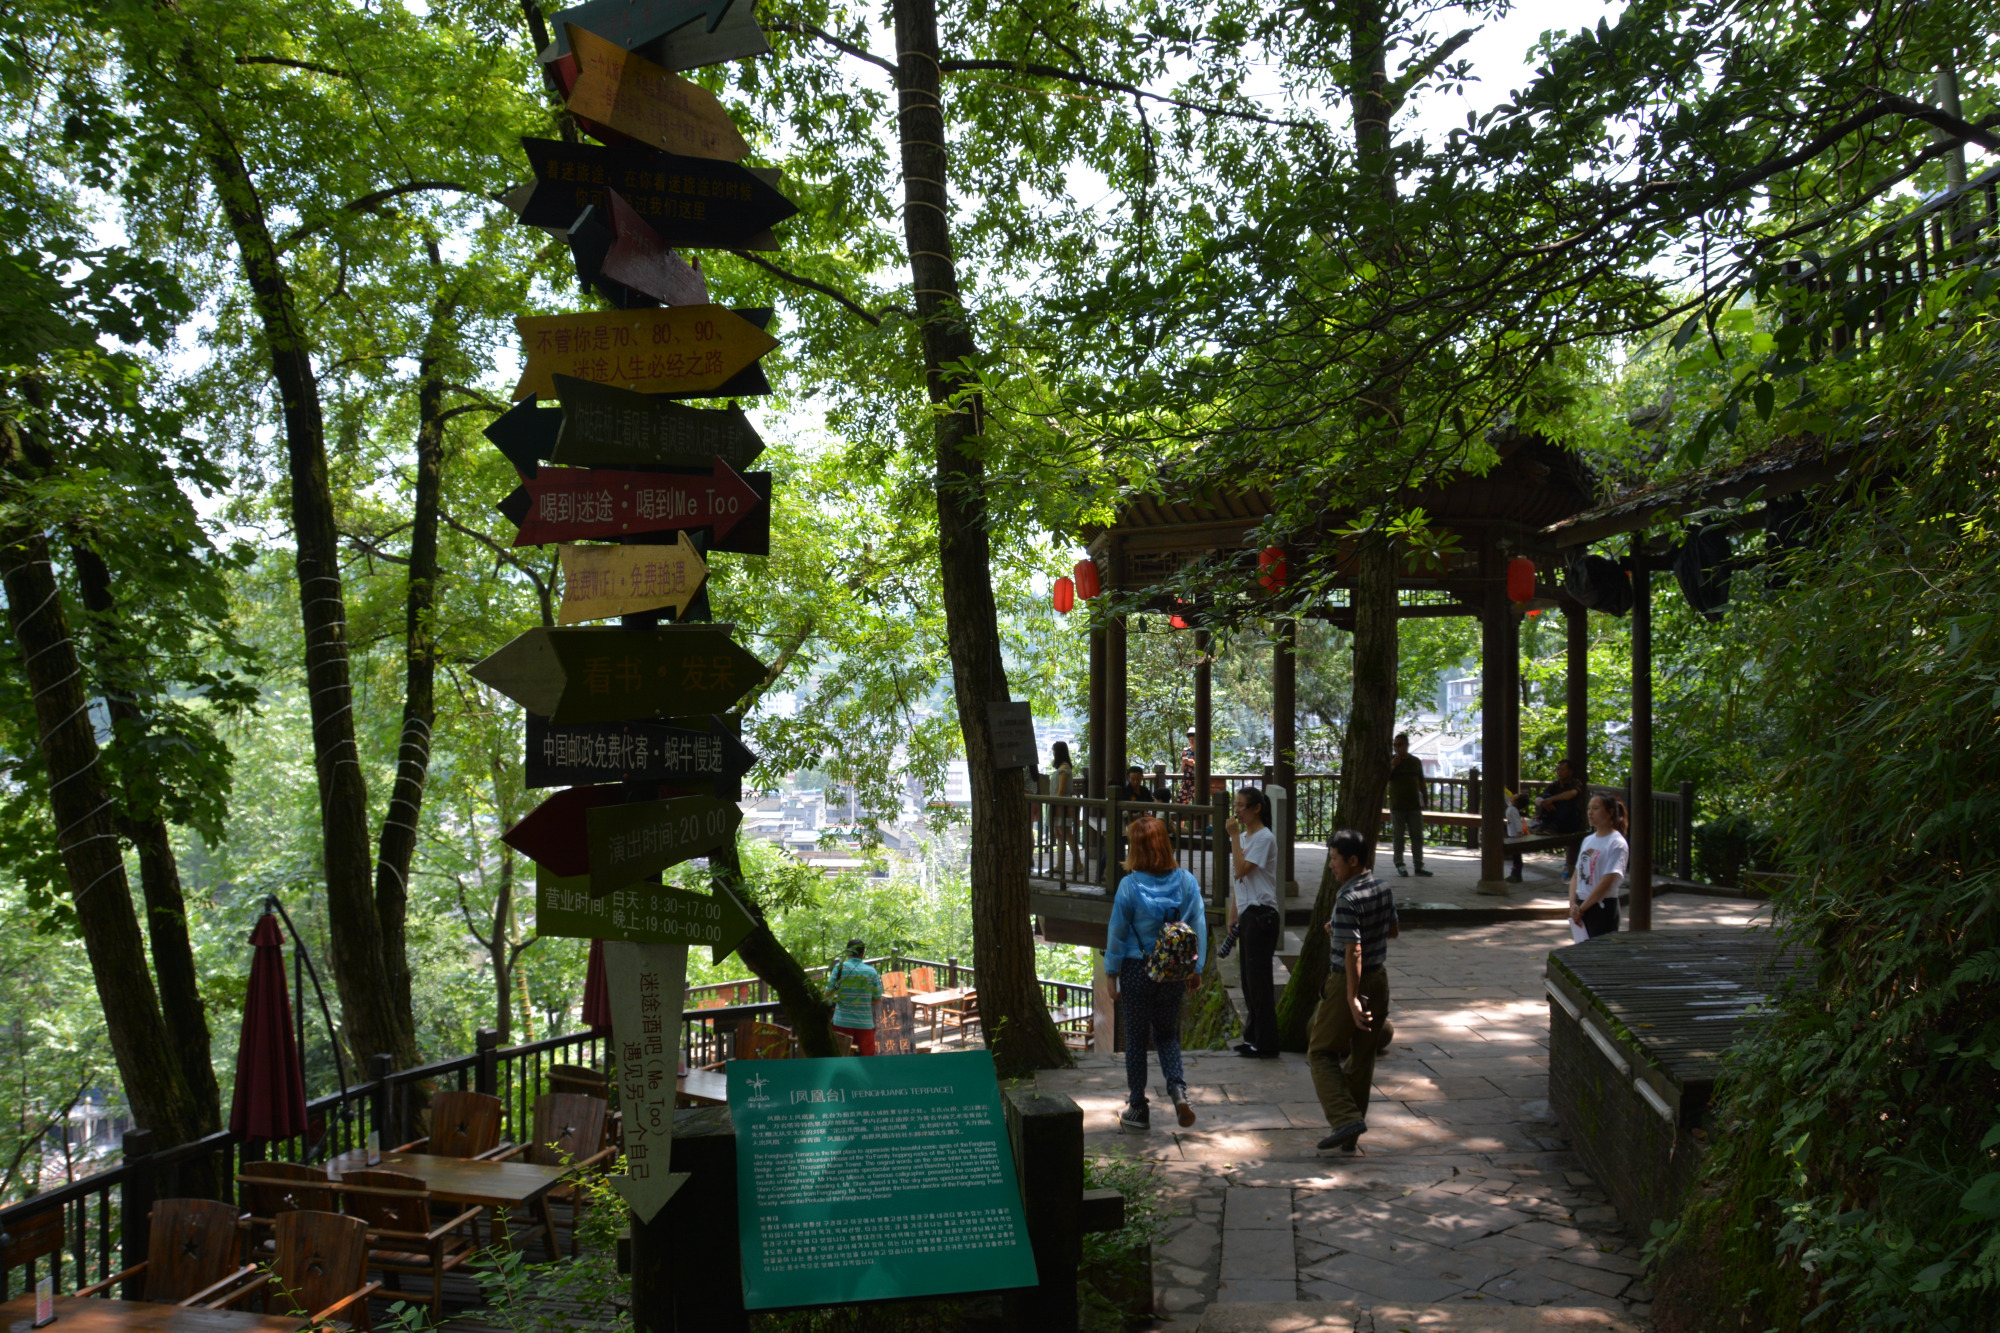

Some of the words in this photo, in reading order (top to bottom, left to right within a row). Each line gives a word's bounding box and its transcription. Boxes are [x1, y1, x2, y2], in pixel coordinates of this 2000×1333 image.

[575, 188, 707, 221] 你可经过我们这里
[706, 488, 739, 515] Too
[622, 1041, 650, 1181] 遇见另一个自己
